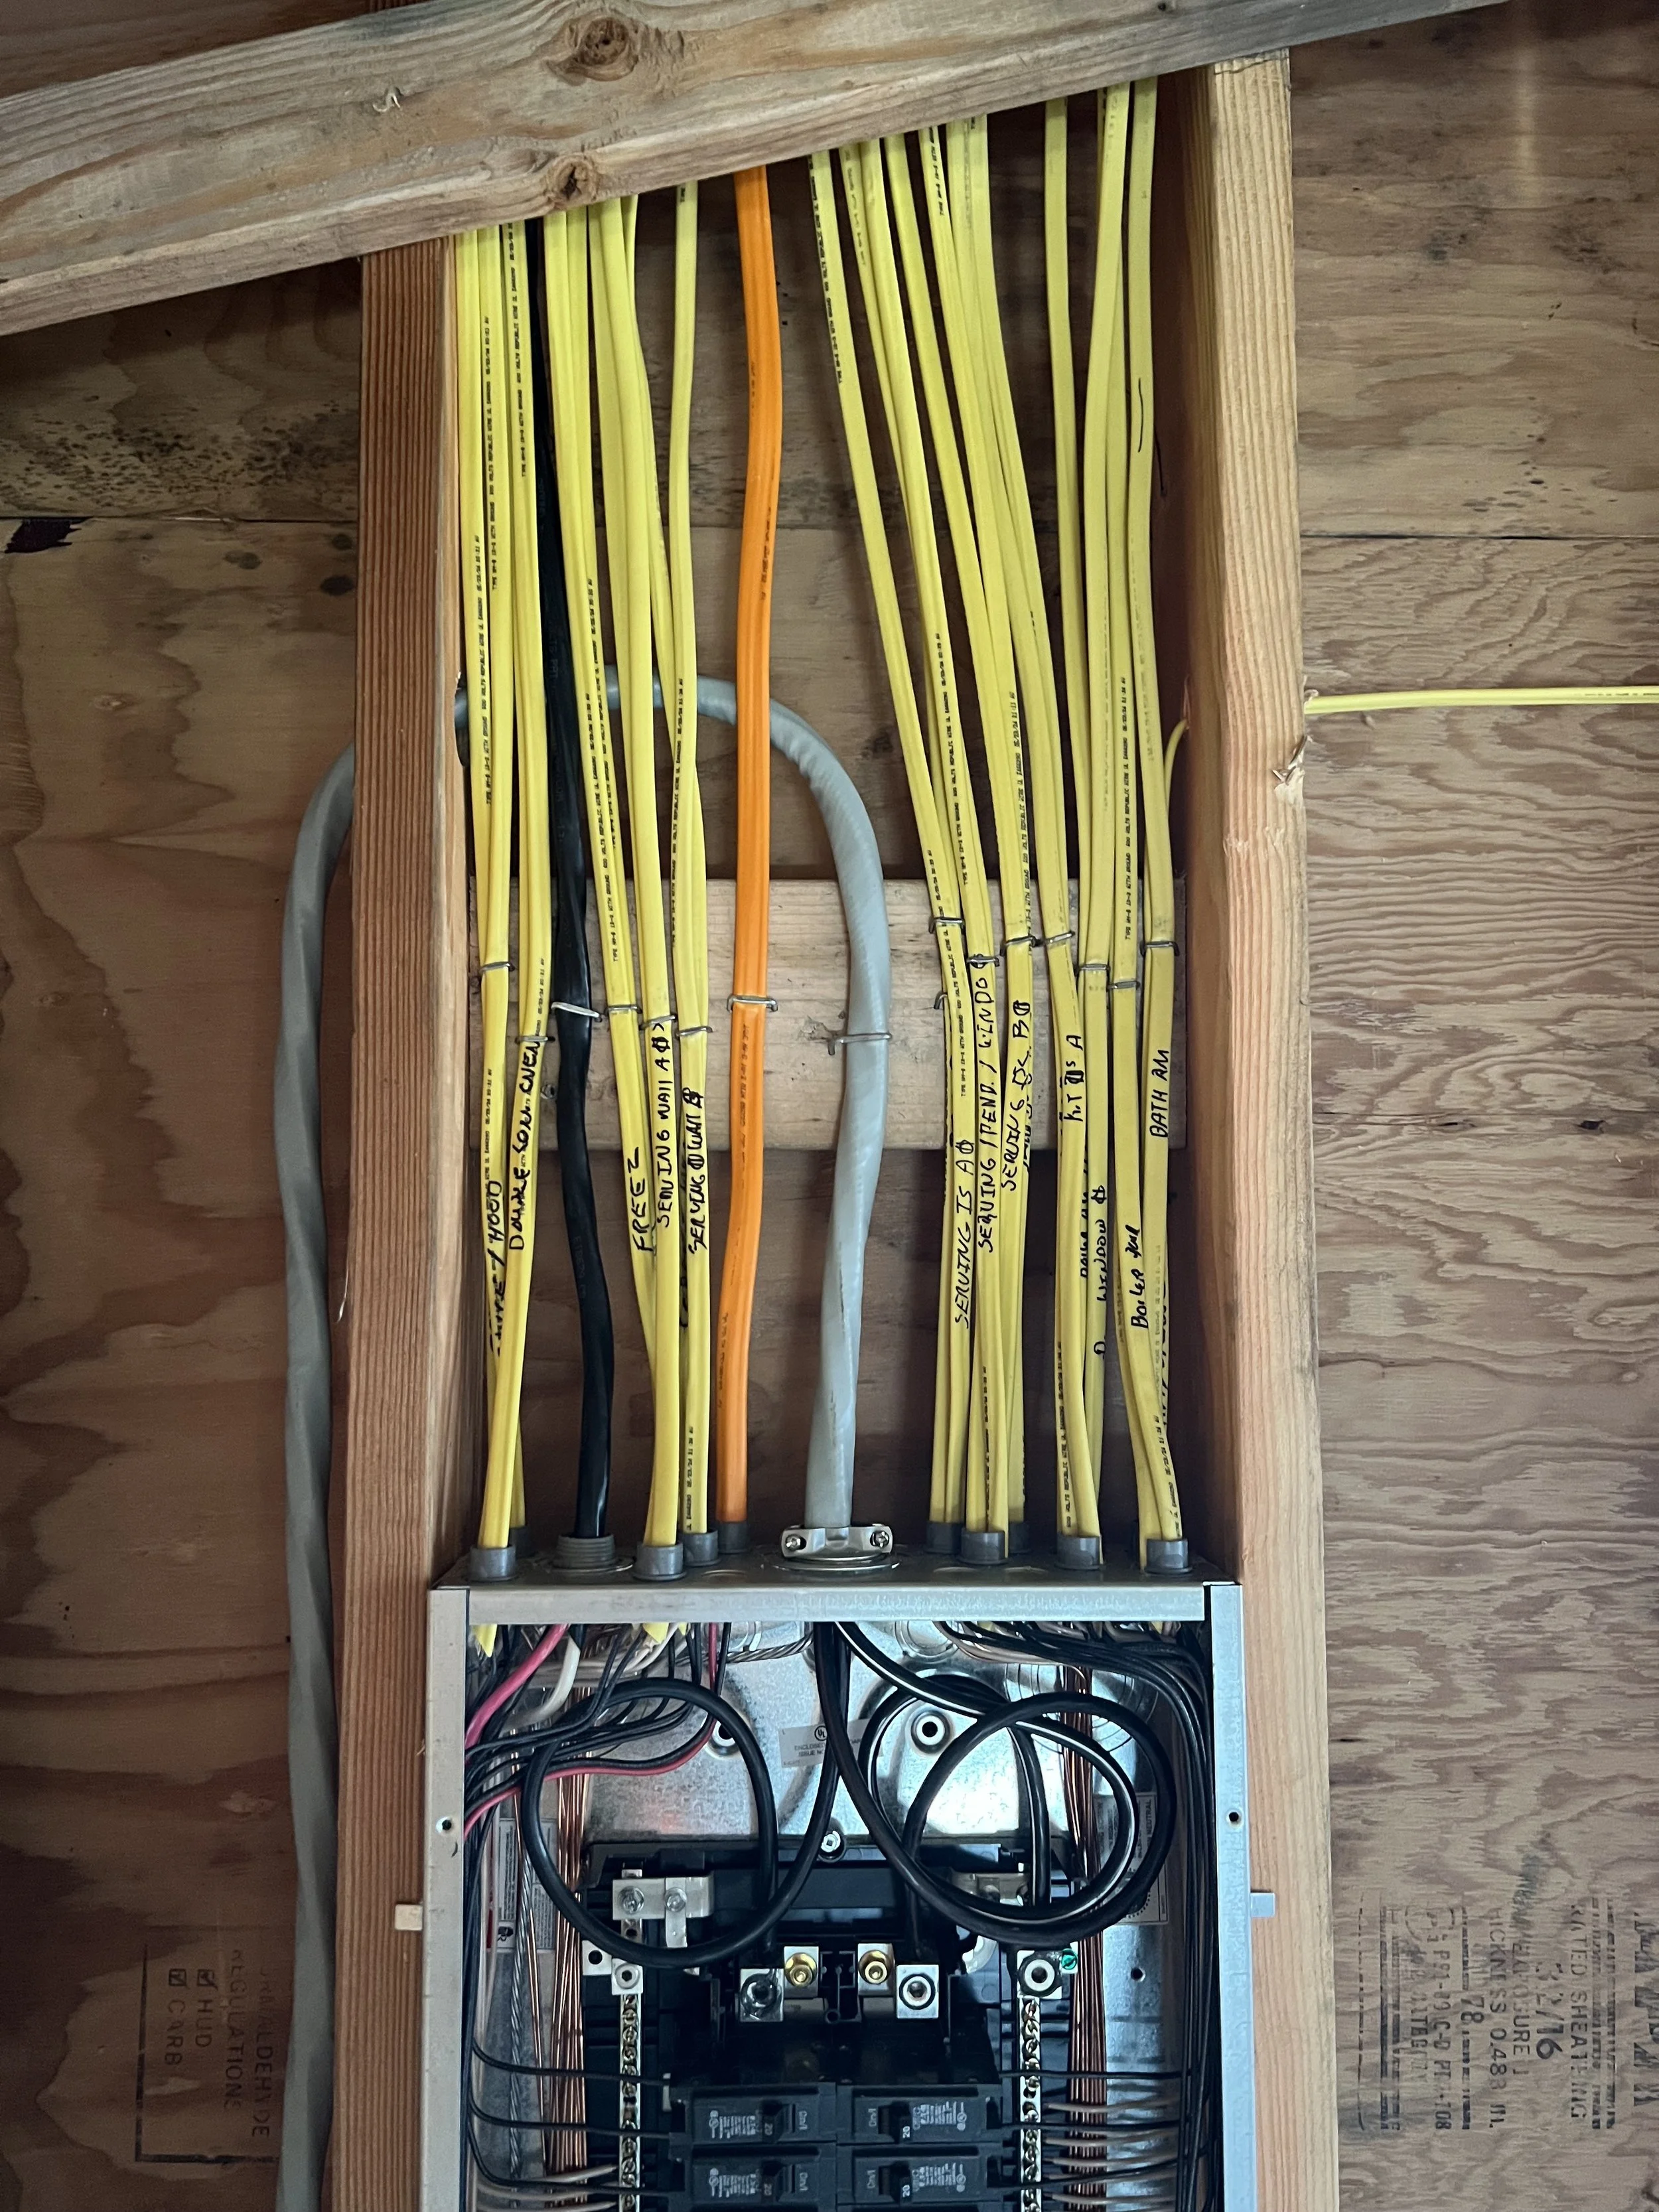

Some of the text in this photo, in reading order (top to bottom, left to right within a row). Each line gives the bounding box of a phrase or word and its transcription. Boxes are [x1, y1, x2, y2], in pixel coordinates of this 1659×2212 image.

[1066, 1035, 1083, 1051] A
[1149, 1090, 1167, 1138] BATH
[487, 1181, 504, 1241] HOOD
[977, 1159, 998, 1252] SERVING
[954, 1218, 973, 1329] SERVING
[1094, 1219, 1106, 1301] WINDOW
[164, 1999, 186, 2066] CARB
[194, 1998, 213, 2047] HUD
[764, 2122, 773, 2136] 20
[903, 2126, 910, 2138] 20
[764, 2183, 772, 2196] 20
[903, 2185, 910, 2198] 20
